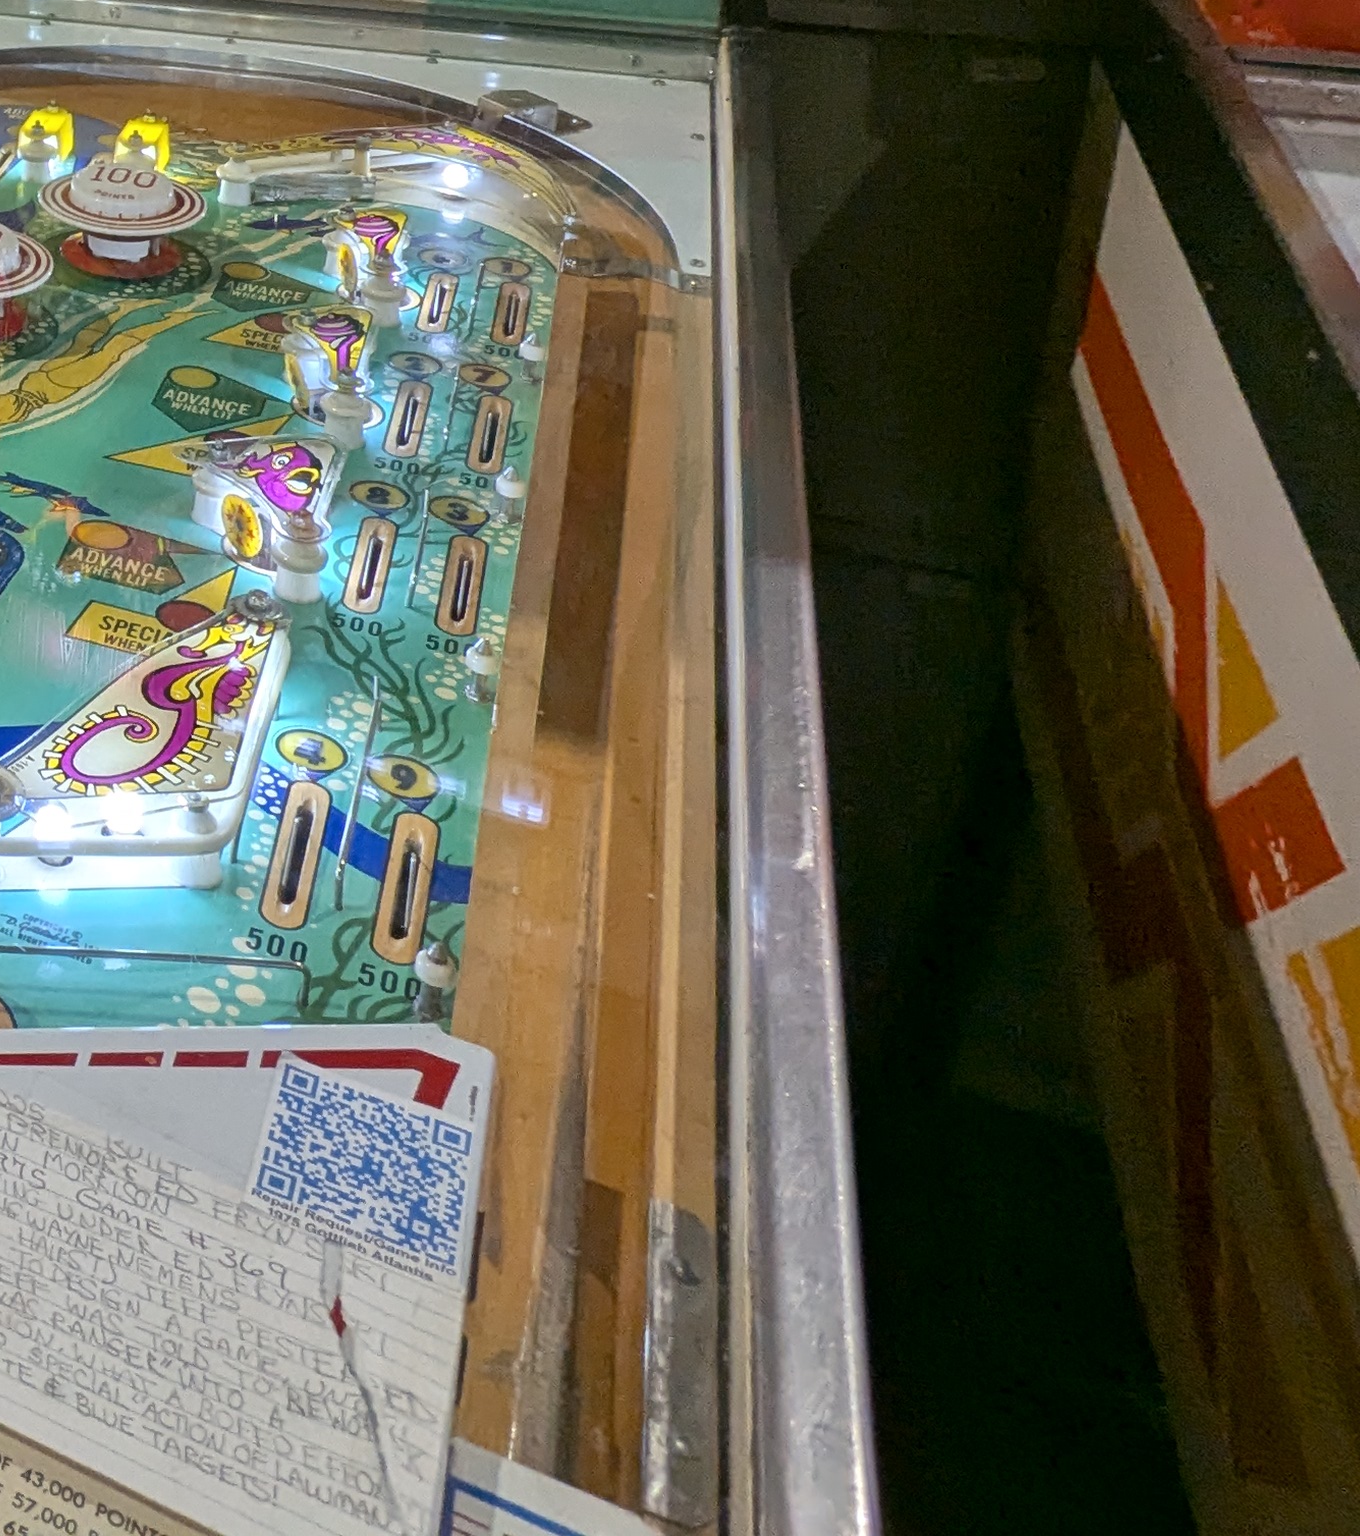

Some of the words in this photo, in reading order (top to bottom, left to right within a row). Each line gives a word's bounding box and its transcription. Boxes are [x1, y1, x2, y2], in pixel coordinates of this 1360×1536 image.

[91, 165, 158, 189] 100
[225, 279, 308, 304] ADVANCE
[472, 367, 497, 384] 7
[162, 387, 252, 418] ADVANCE
[169, 399, 212, 417] WHEN
[445, 501, 471, 521] 3
[69, 547, 170, 582] ADVANCE
[79, 561, 126, 584] WHEN
[125, 570, 151, 587] LIT
[330, 611, 383, 638] 500
[103, 632, 148, 654] WHEN
[245, 926, 308, 965] 500
[358, 963, 422, 1001] 500
[76, 1188, 168, 1241] GAME
[218, 1245, 288, 1290] 369
[250, 1186, 300, 1215] Repair
[304, 1207, 421, 1263] Request/Game
[424, 1256, 458, 1277] Info
[267, 1206, 301, 1230] 1975
[303, 1221, 369, 1256] Gottlieb
[371, 1249, 434, 1283] Atlantis
